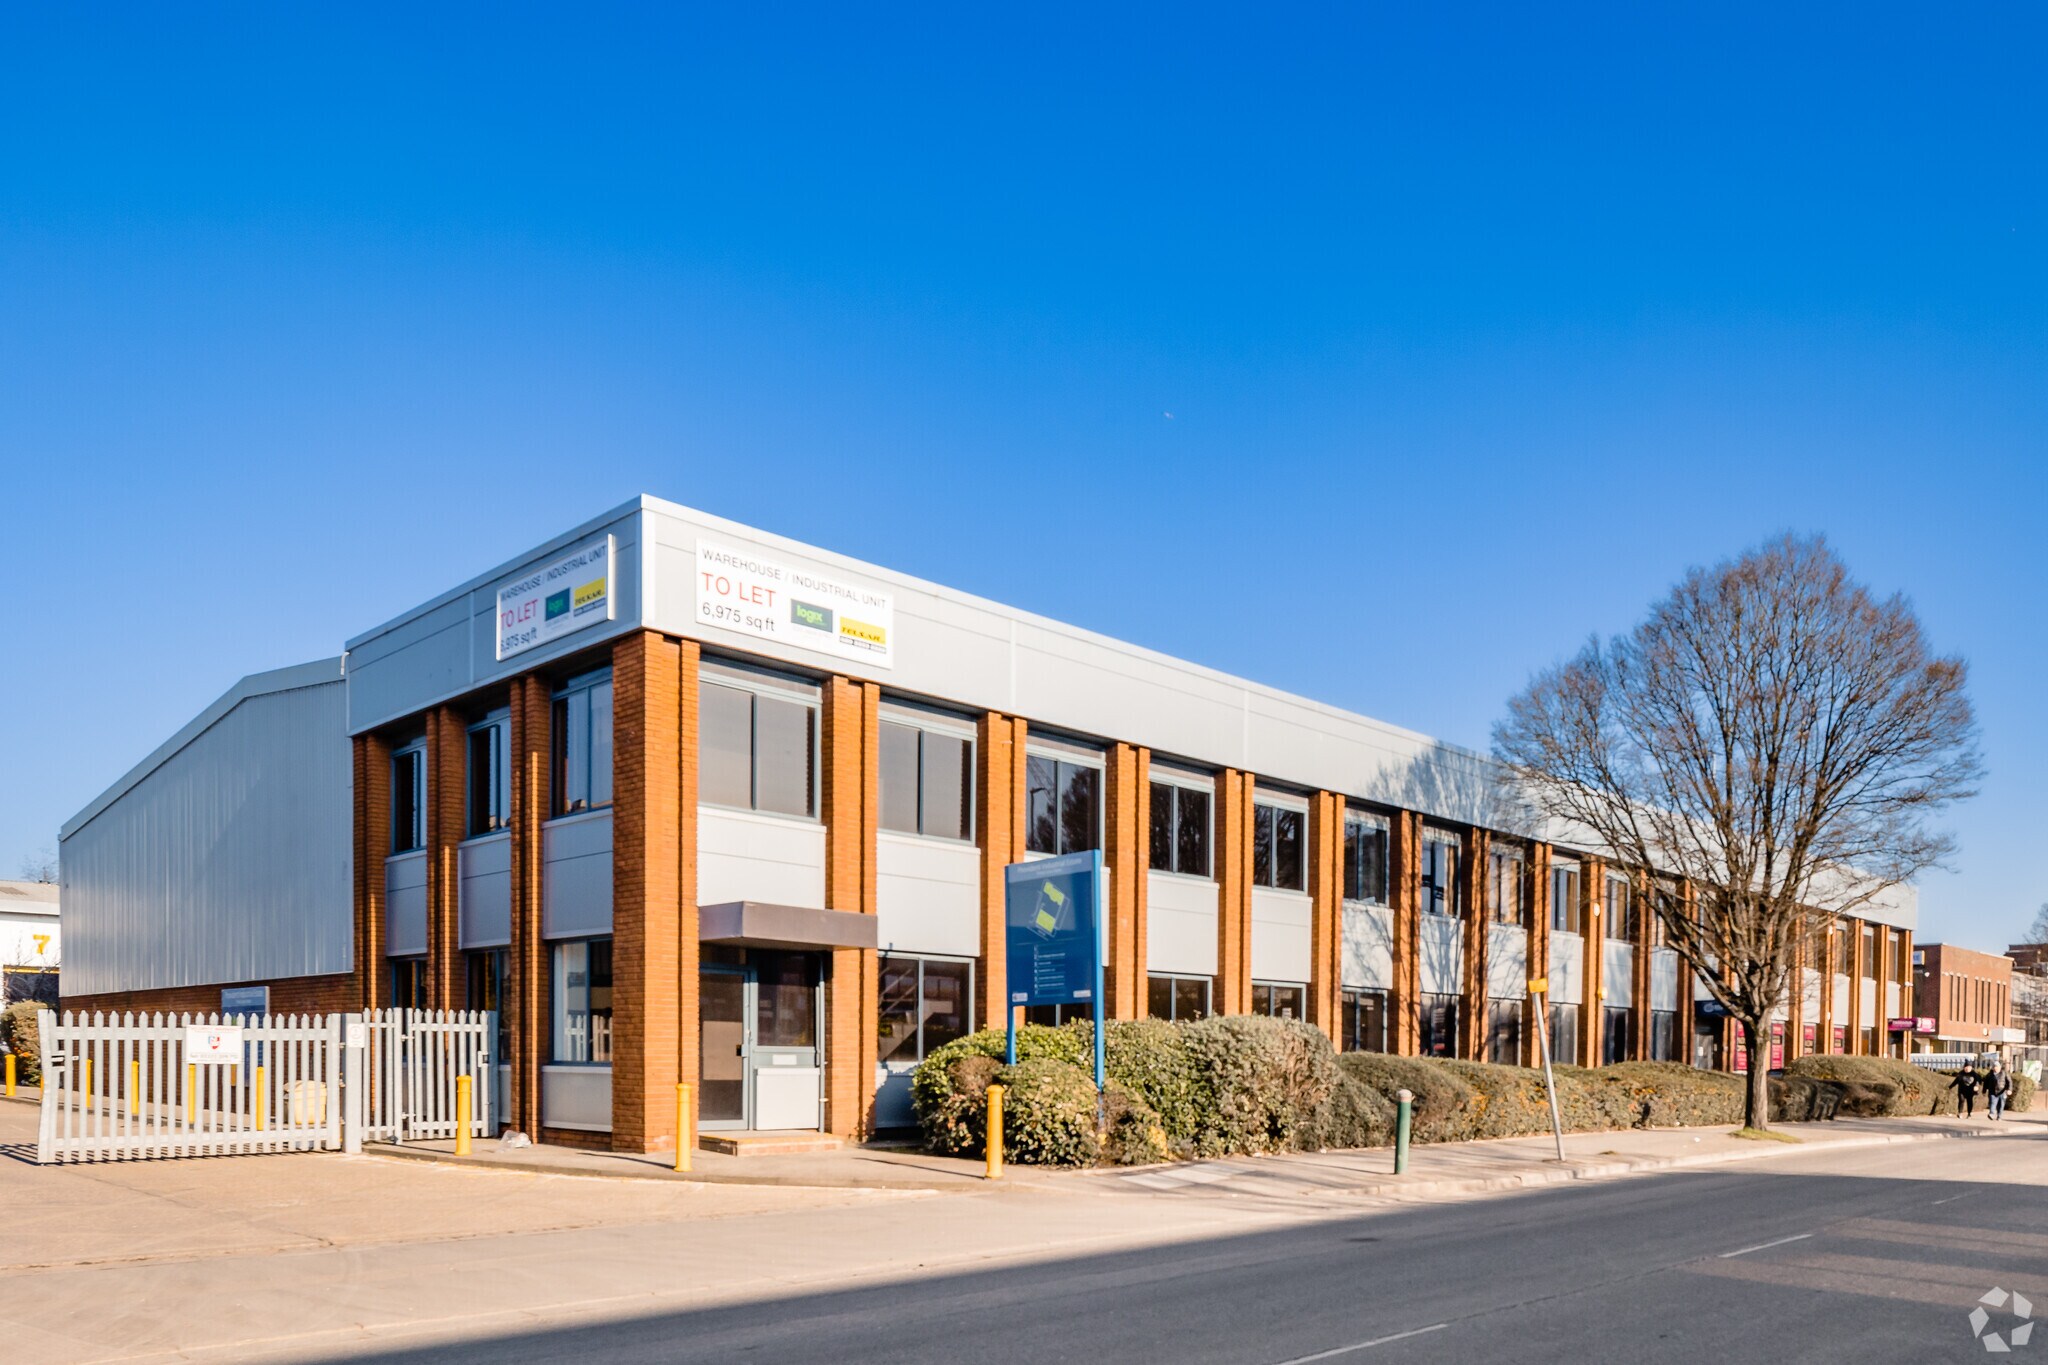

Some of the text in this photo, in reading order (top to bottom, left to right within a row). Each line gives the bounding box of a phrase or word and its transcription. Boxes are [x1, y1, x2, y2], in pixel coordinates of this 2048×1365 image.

[500, 575, 541, 601] WAREHOUSE
[546, 555, 587, 581] INDUSTRIAL
[588, 545, 607, 563] UNIT
[701, 572, 777, 608] TO LET
[702, 548, 781, 580] WAREHOUSE
[792, 573, 859, 602] INDUSTRIAL
[862, 594, 886, 608] UNIT
[500, 609, 515, 631] TO
[517, 598, 539, 624] LET
[702, 601, 741, 623] 6,975
[33, 934, 51, 954] 7
